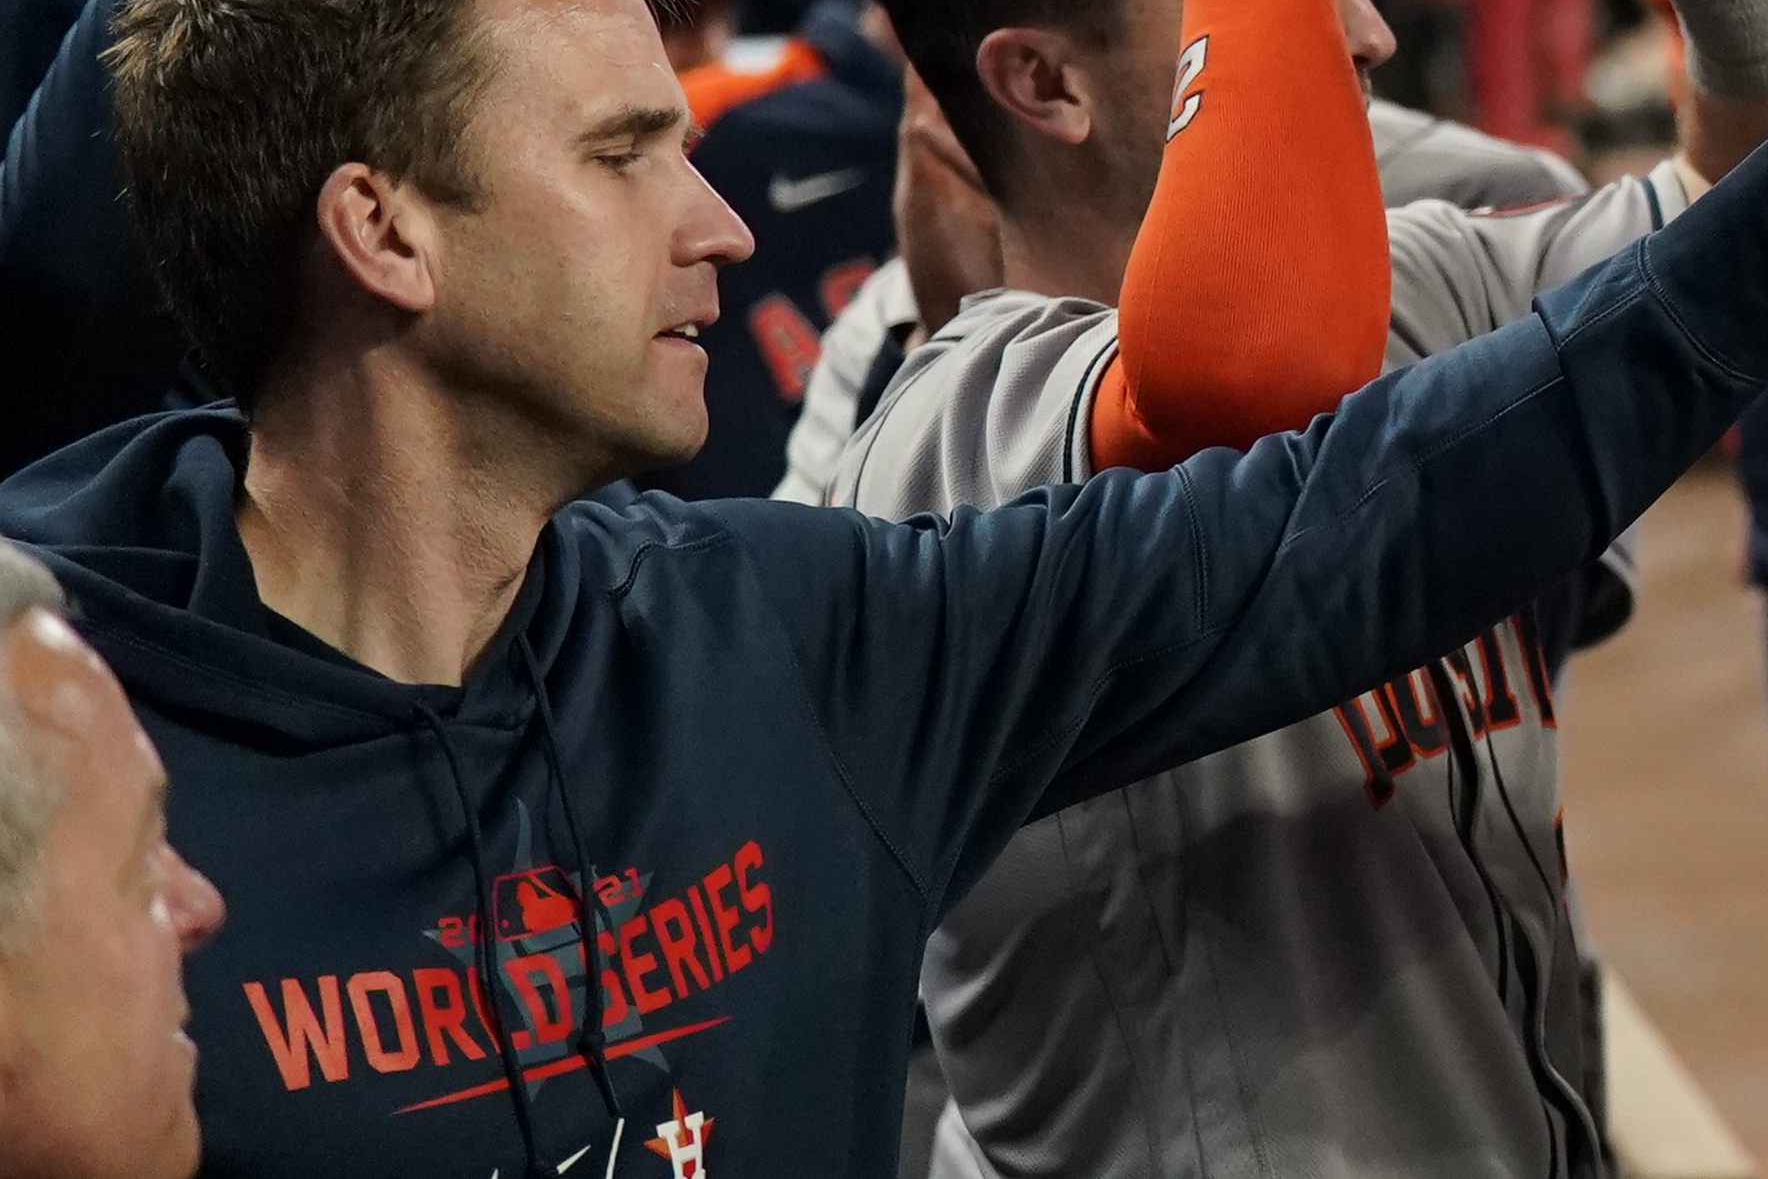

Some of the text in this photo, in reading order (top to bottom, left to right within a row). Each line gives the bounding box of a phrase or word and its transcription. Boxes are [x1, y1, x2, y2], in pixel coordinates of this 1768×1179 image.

[592, 867, 645, 907] 21
[243, 839, 775, 1091] WORLD SERIES
